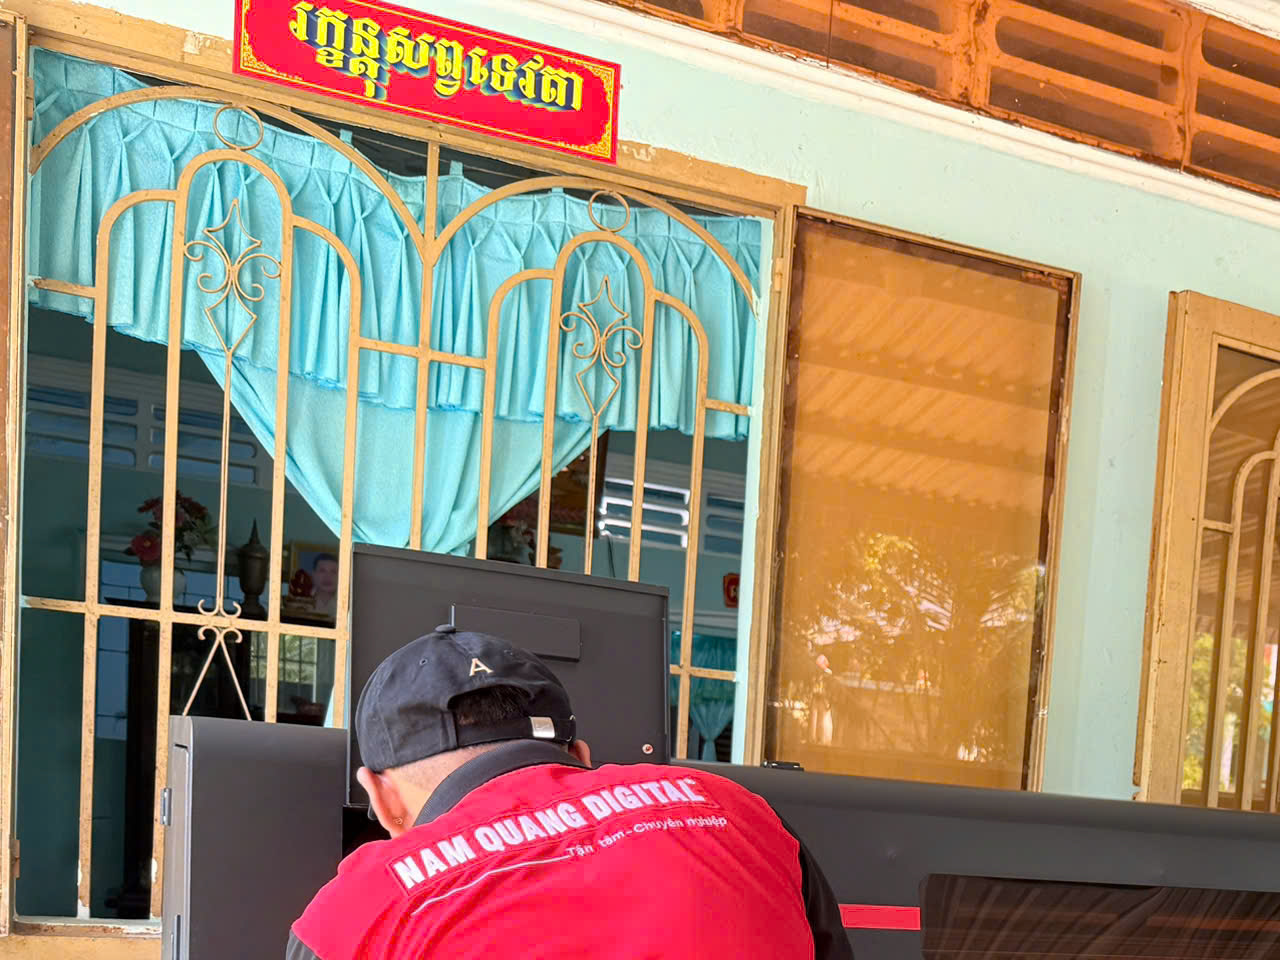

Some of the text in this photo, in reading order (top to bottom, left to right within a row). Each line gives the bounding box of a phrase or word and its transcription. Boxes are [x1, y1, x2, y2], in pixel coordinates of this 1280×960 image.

[469, 657, 494, 677] A
[392, 777, 706, 890] NAM QUANG DIGITAL
